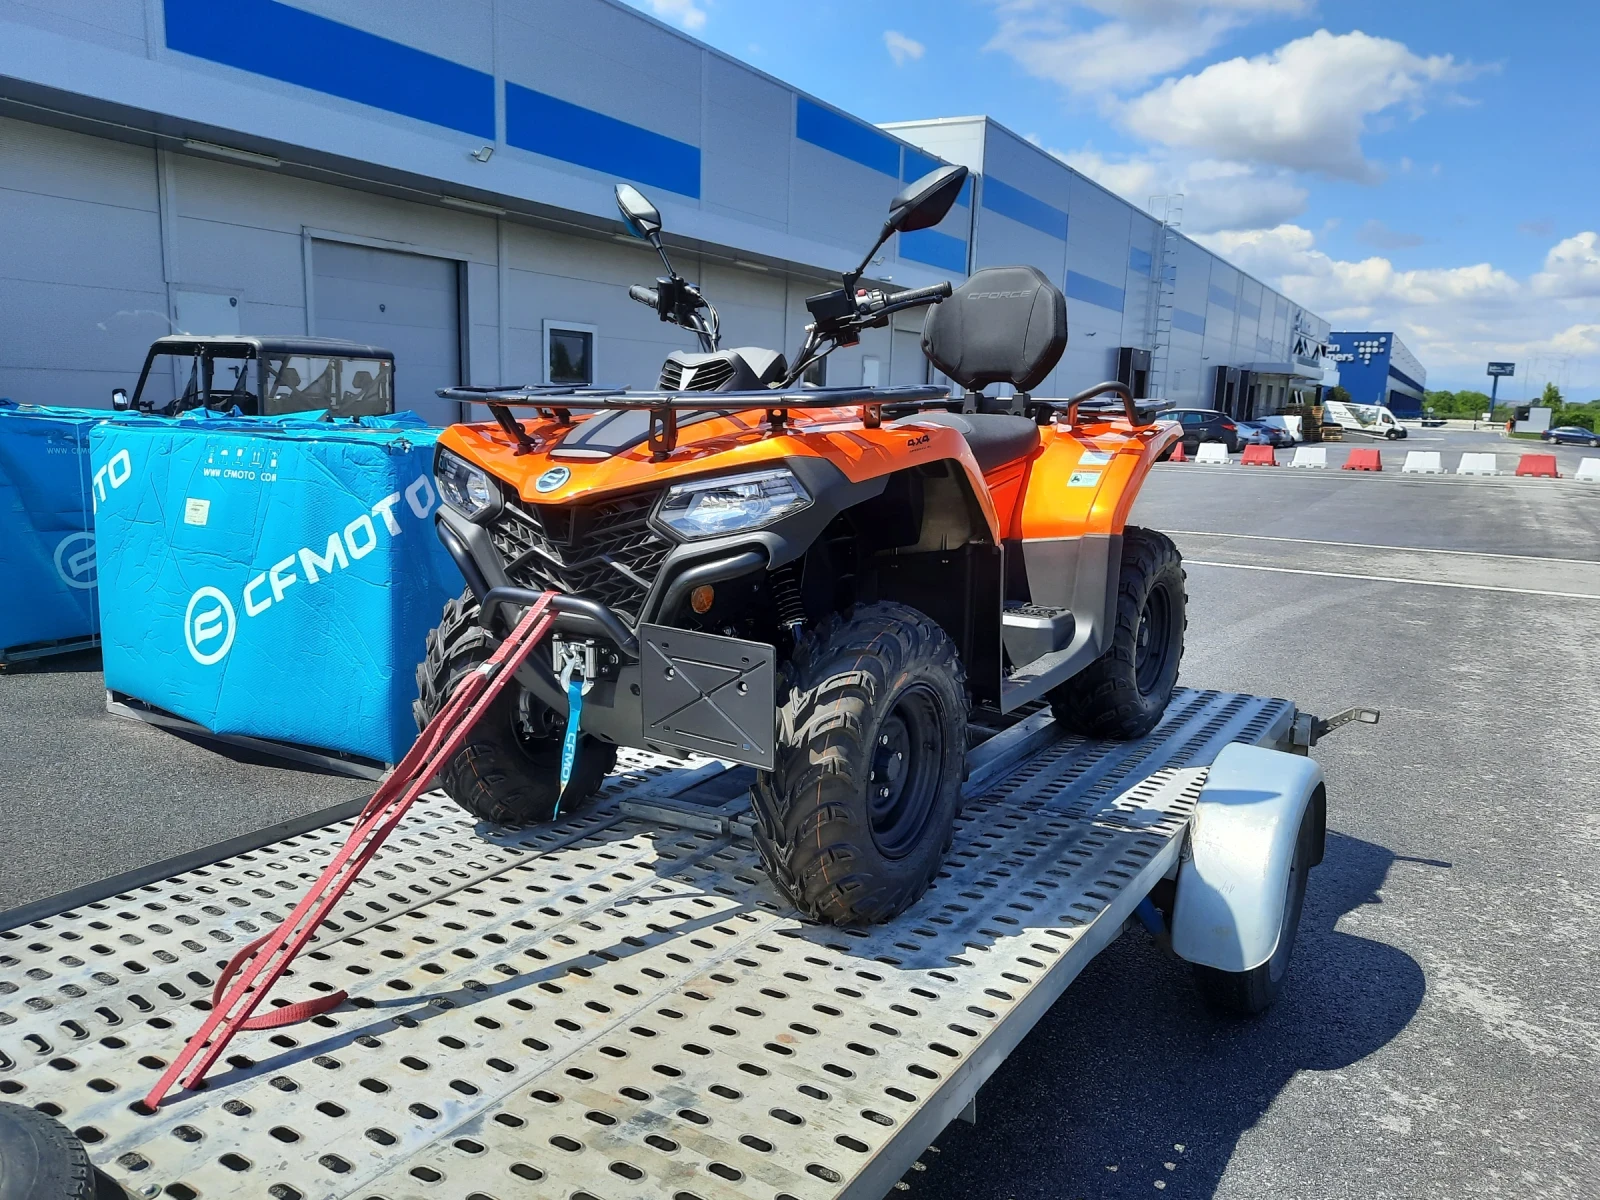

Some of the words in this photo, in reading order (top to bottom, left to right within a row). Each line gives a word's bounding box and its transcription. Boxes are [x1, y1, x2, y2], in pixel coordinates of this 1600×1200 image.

[967, 290, 1031, 300] CFORCE
[46, 447, 68, 455] WWW
[203, 467, 221, 477] WWW
[223, 469, 256, 481] CFMOTO
[92, 448, 132, 516] TO
[243, 473, 436, 618] CFMOTO
